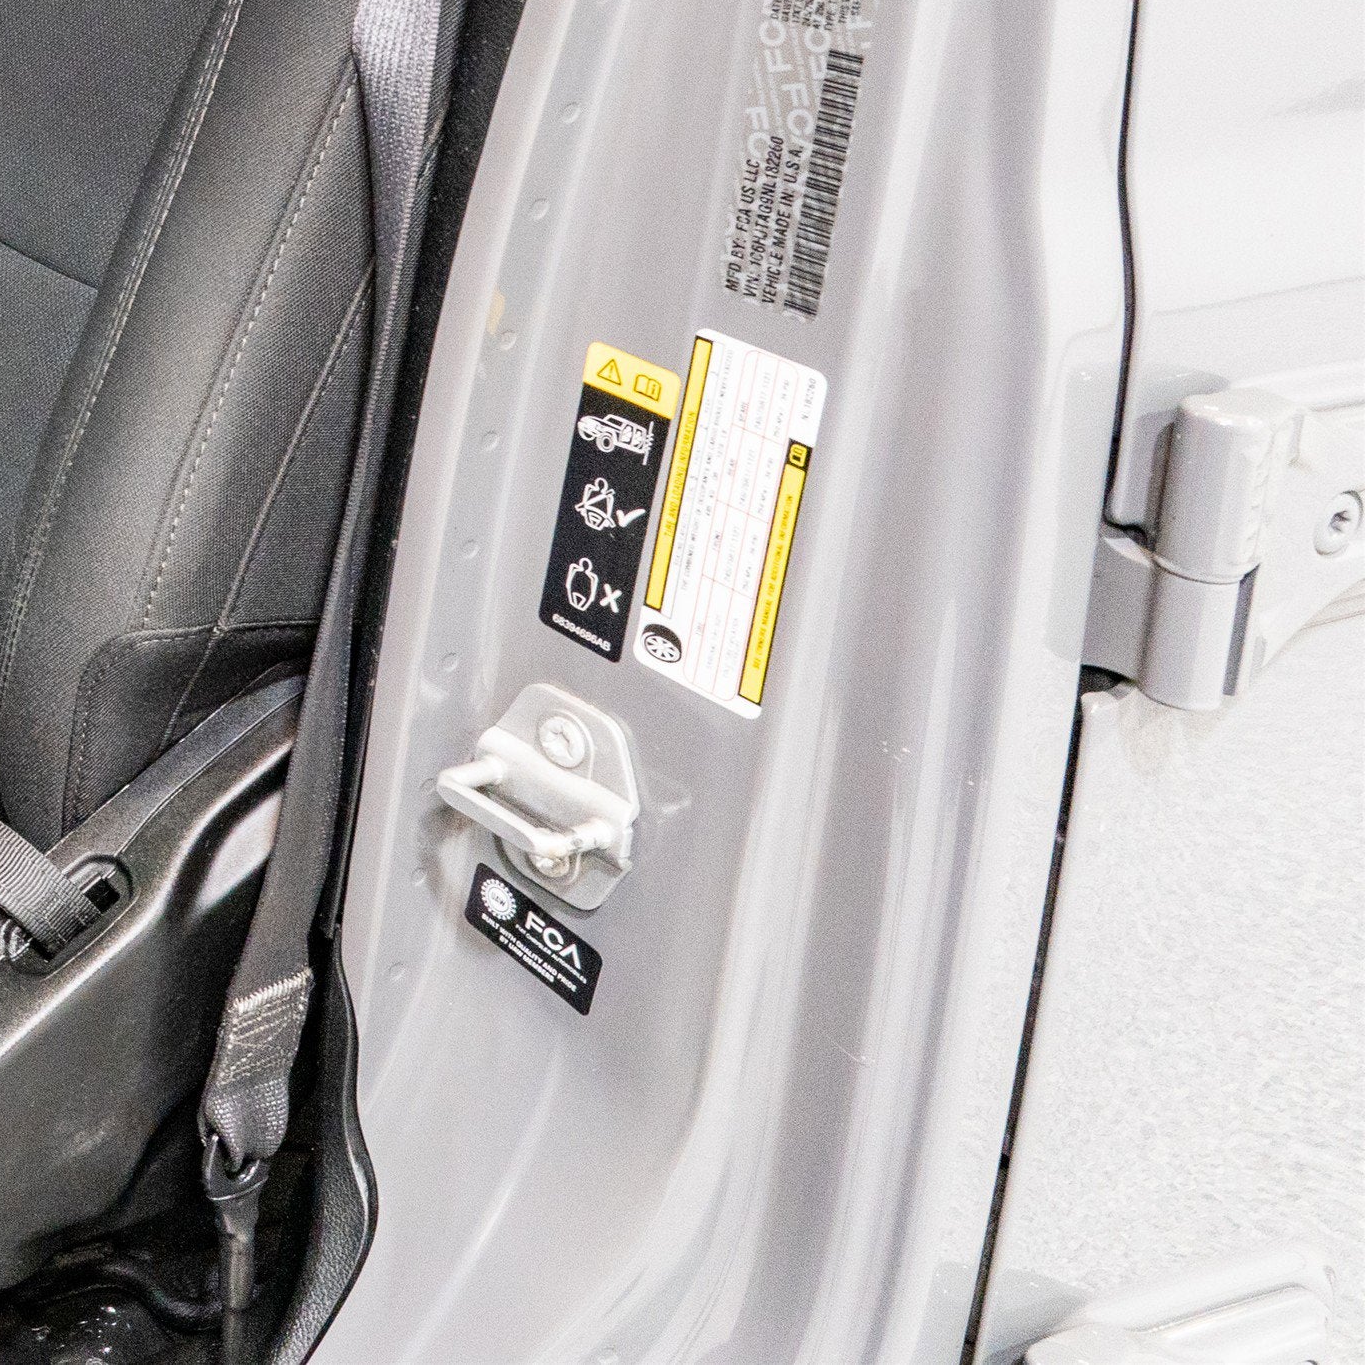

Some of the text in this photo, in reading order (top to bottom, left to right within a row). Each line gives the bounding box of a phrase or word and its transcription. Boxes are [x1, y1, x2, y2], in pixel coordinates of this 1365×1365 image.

[724, 157, 760, 292] MFD BY: FCA US LLC
[771, 208, 791, 249] MADE
[761, 249, 783, 306] VEHICLE
[678, 409, 696, 464] INFORMATION
[670, 464, 685, 501] LOADING
[667, 500, 678, 518] AND
[523, 908, 585, 970] FCA
[542, 961, 557, 976] AND
